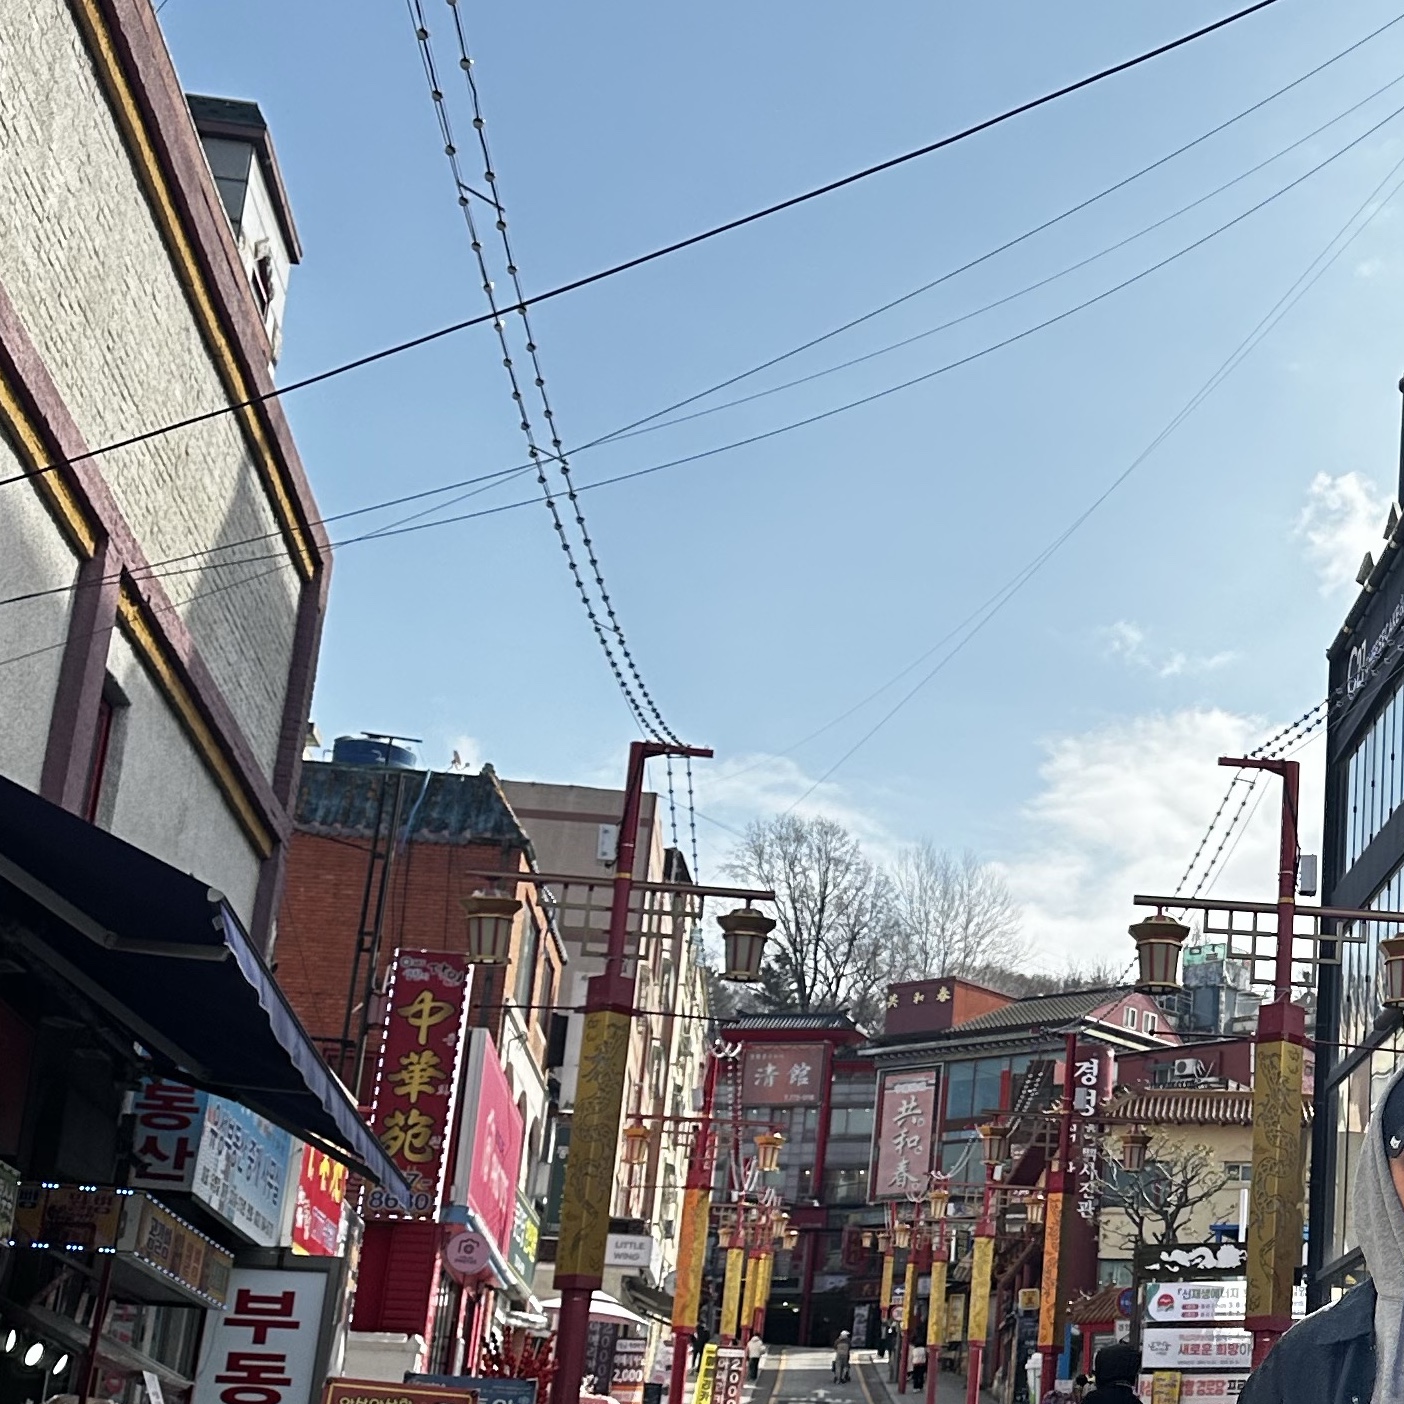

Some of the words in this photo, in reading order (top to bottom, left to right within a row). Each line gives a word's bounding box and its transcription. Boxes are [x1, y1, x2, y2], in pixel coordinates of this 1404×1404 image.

[381, 989, 455, 1163] 中華苑
[887, 1094, 923, 1190] 共和春
[367, 1190, 430, 1212] 860
[614, 1241, 646, 1250] LITTLE
[613, 1251, 640, 1261] WING
[1178, 1342, 1213, 1356] 새로운
